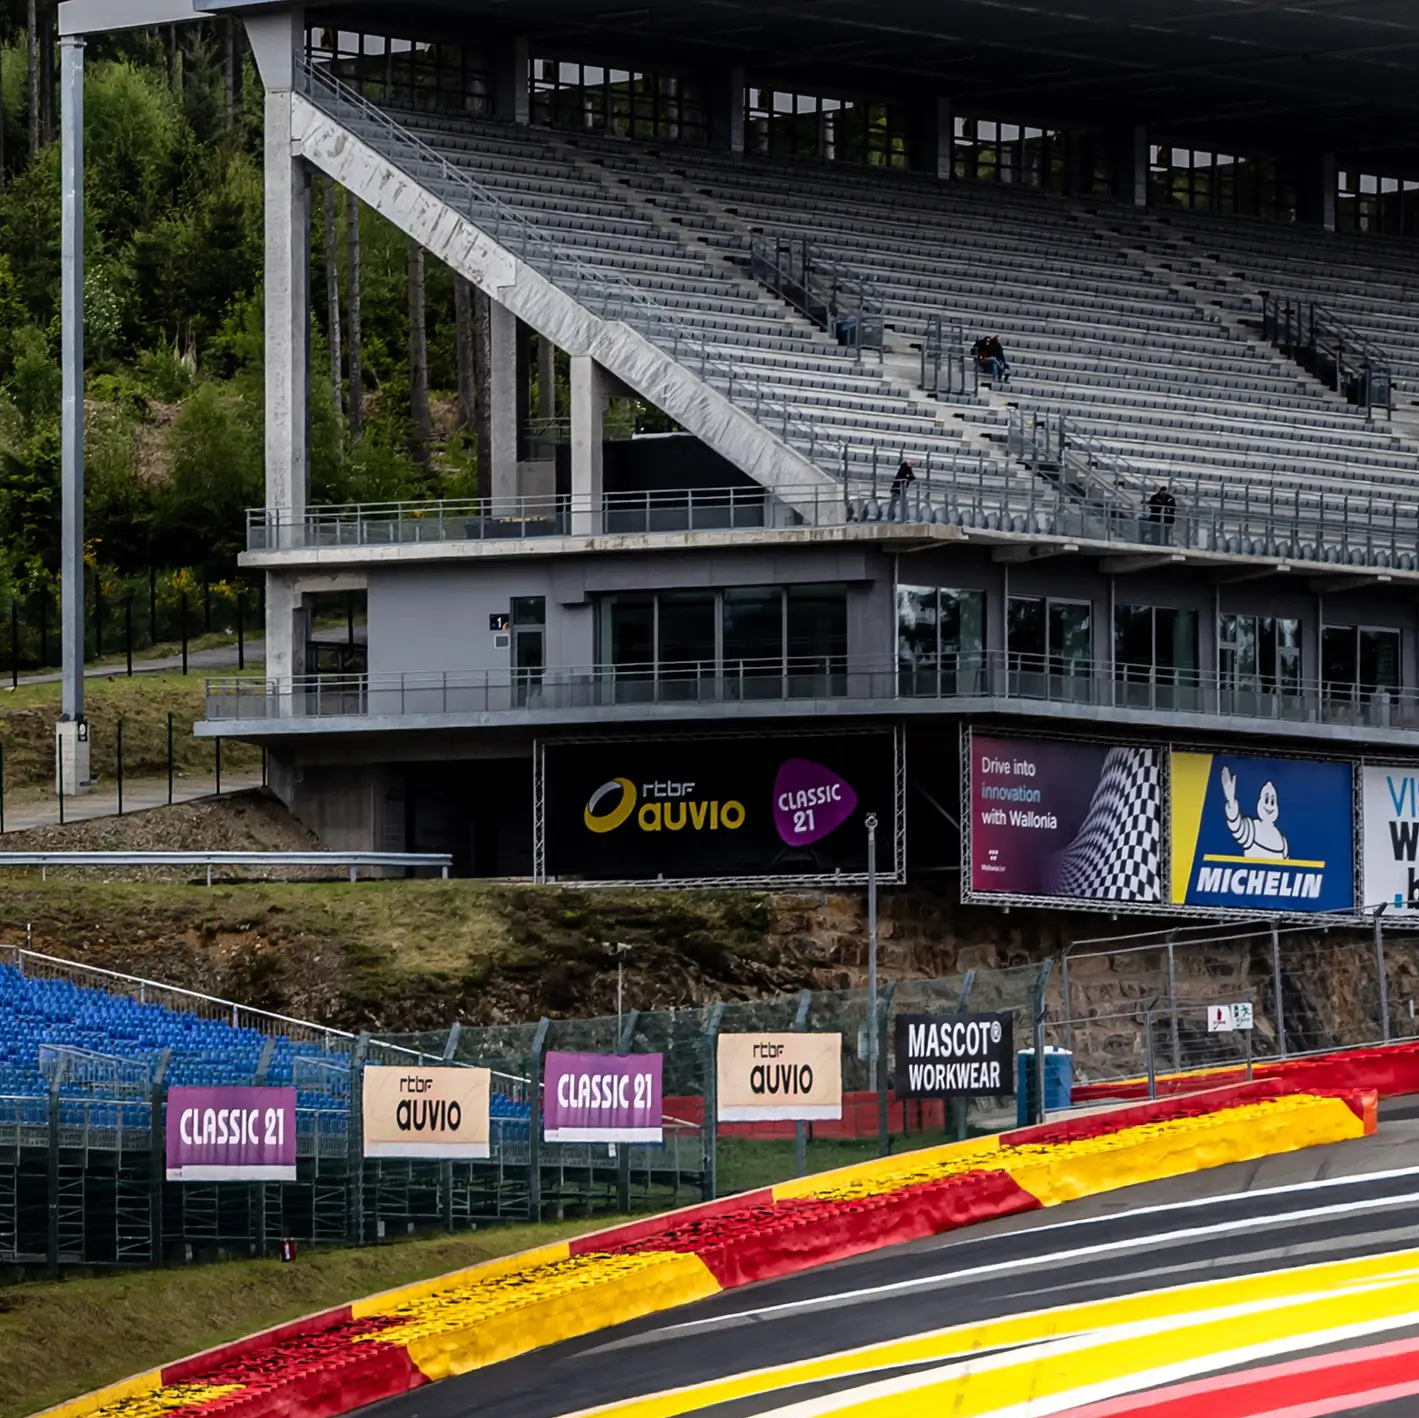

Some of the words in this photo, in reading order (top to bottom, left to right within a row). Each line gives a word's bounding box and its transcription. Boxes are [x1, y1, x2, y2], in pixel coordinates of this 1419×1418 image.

[981, 756, 1011, 775] Drive
[1013, 758, 1037, 777] into
[778, 783, 842, 811] CLASSIC
[981, 782, 1041, 803] innovation
[638, 800, 746, 831] auvio
[793, 809, 816, 833] 21
[981, 808, 1007, 826] with
[1009, 810, 1058, 829] Wallonia
[1196, 867, 1323, 898] MICHELIN
[557, 1073, 629, 1108] CLASSIC
[634, 1073, 653, 1108] 21
[750, 1063, 813, 1094] auvio
[908, 1061, 1001, 1091] WORKWEAR
[180, 1107, 260, 1145] CLASSIC
[264, 1107, 285, 1145] 21
[396, 1099, 462, 1132] auvio
